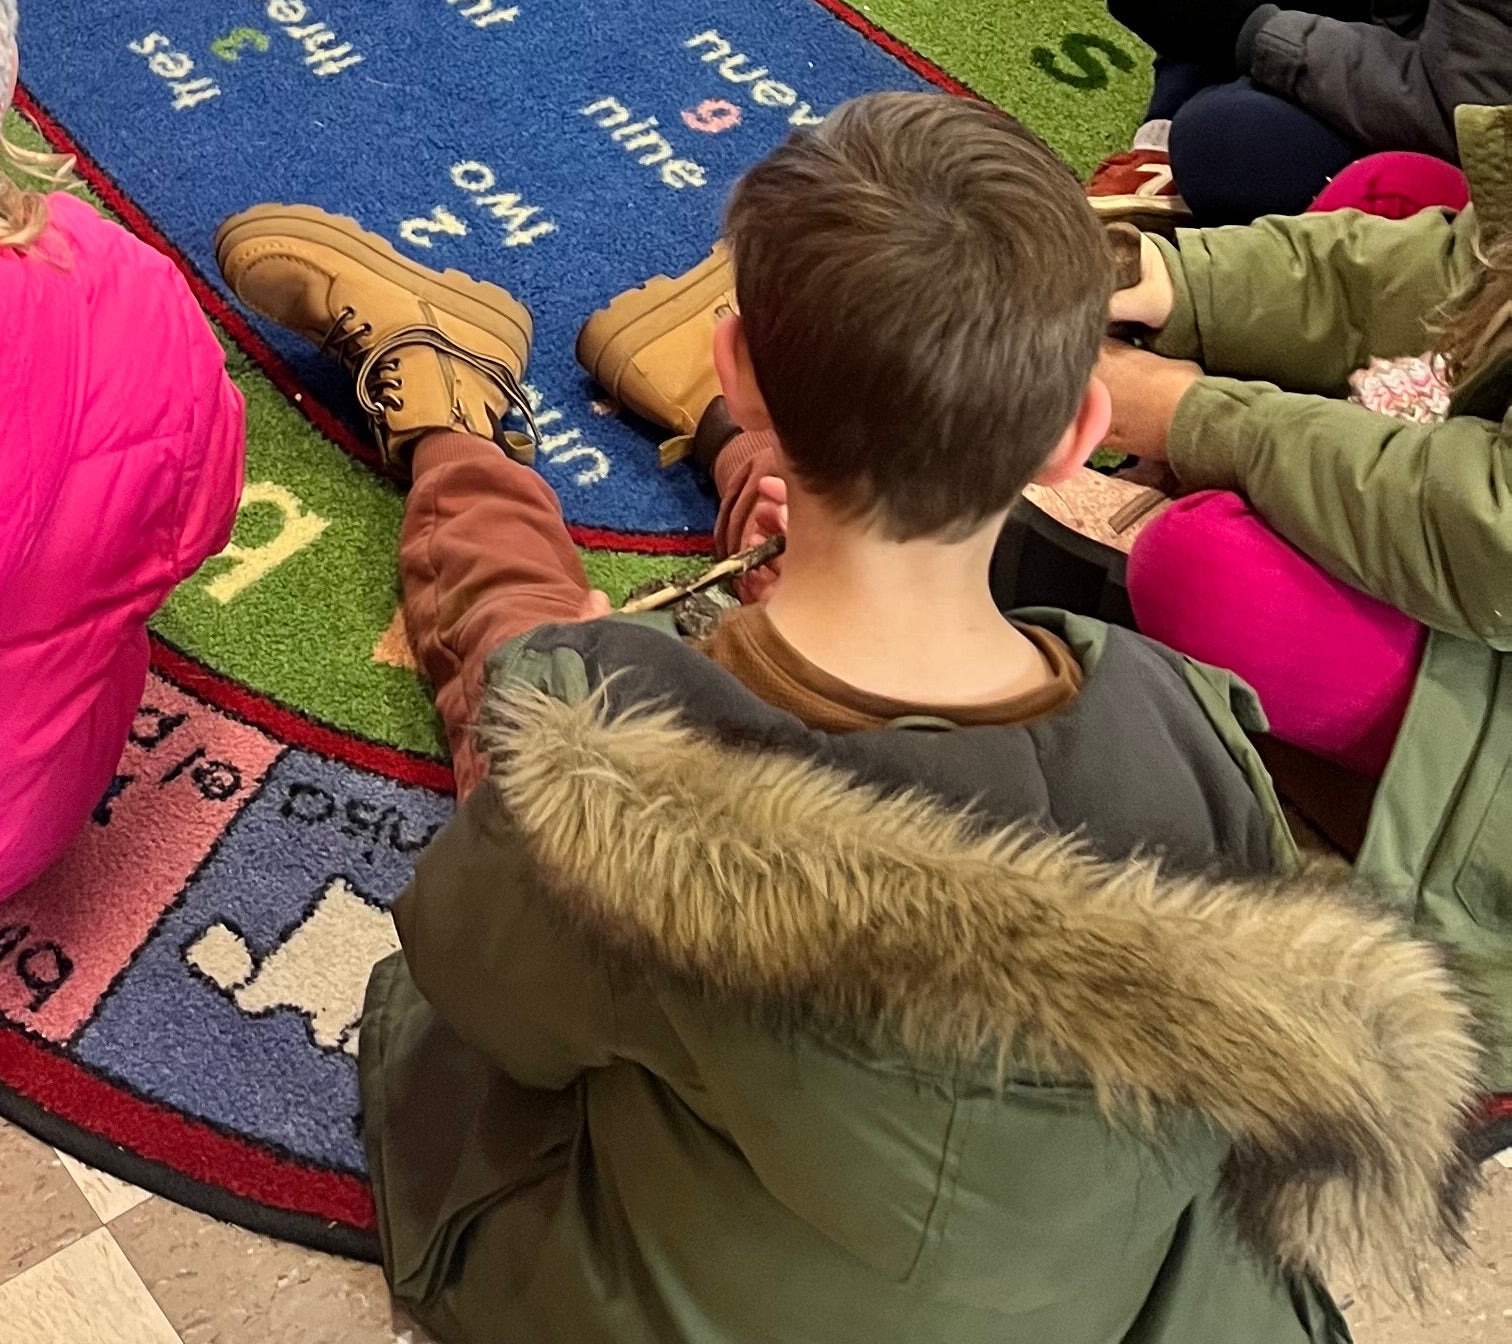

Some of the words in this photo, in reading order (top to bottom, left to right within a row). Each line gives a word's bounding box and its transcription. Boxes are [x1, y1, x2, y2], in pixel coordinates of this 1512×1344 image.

[128, 30, 223, 111] tres
[210, 26, 270, 62] 3
[685, 29, 824, 128] nuev
[580, 96, 707, 189] nine
[681, 98, 742, 134] 9
[399, 205, 468, 248] 2
[450, 159, 559, 247] two
